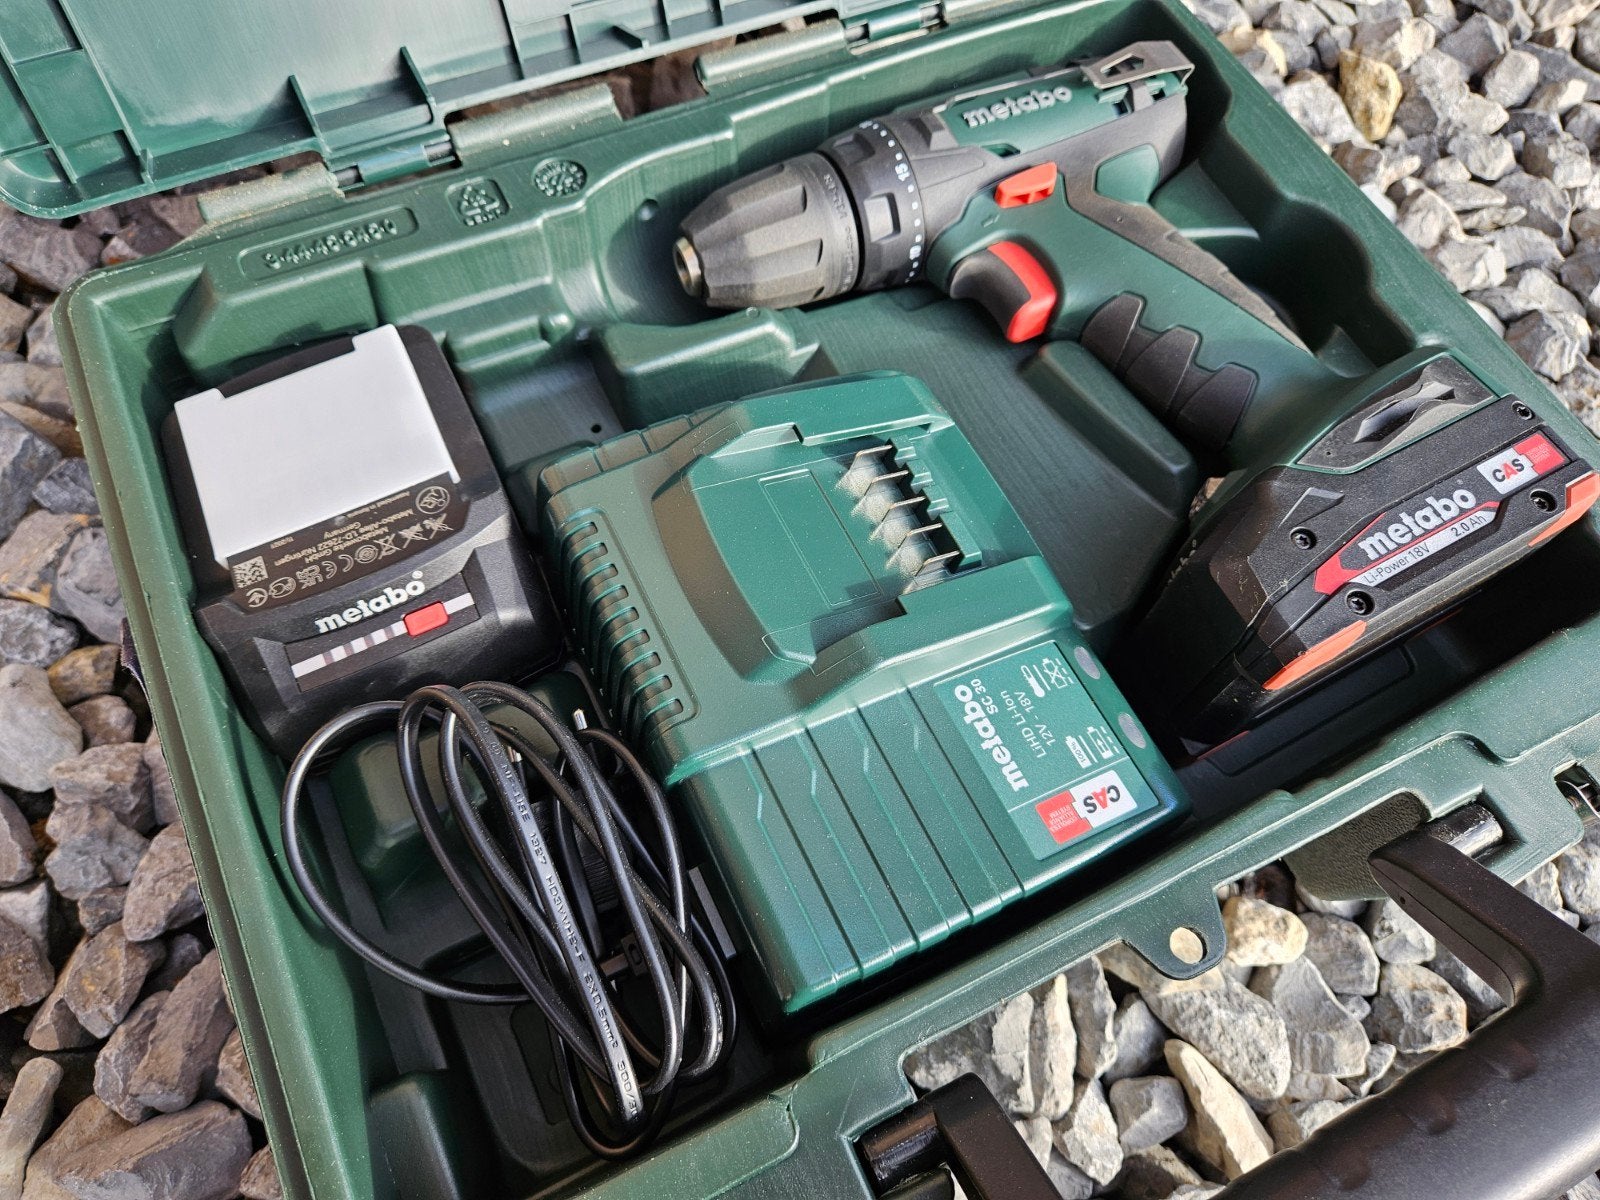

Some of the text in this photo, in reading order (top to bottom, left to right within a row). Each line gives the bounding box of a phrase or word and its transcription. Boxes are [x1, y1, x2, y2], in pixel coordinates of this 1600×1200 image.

[963, 86, 1073, 128] metabo
[1492, 458, 1525, 483] CAS
[323, 521, 361, 539] Germany
[1358, 489, 1477, 561] metabo
[305, 548, 333, 564] GmbH
[1364, 515, 1488, 585] Li-Power 18V 2.0 Ah
[315, 580, 426, 634] metabo
[970, 678, 999, 715] SC 30
[1014, 691, 1035, 713] 18V
[954, 684, 1030, 792] metabo
[1000, 690, 1047, 758] LiHD Li-Ion
[1034, 724, 1056, 747] 12V
[1083, 784, 1121, 814] CAS
